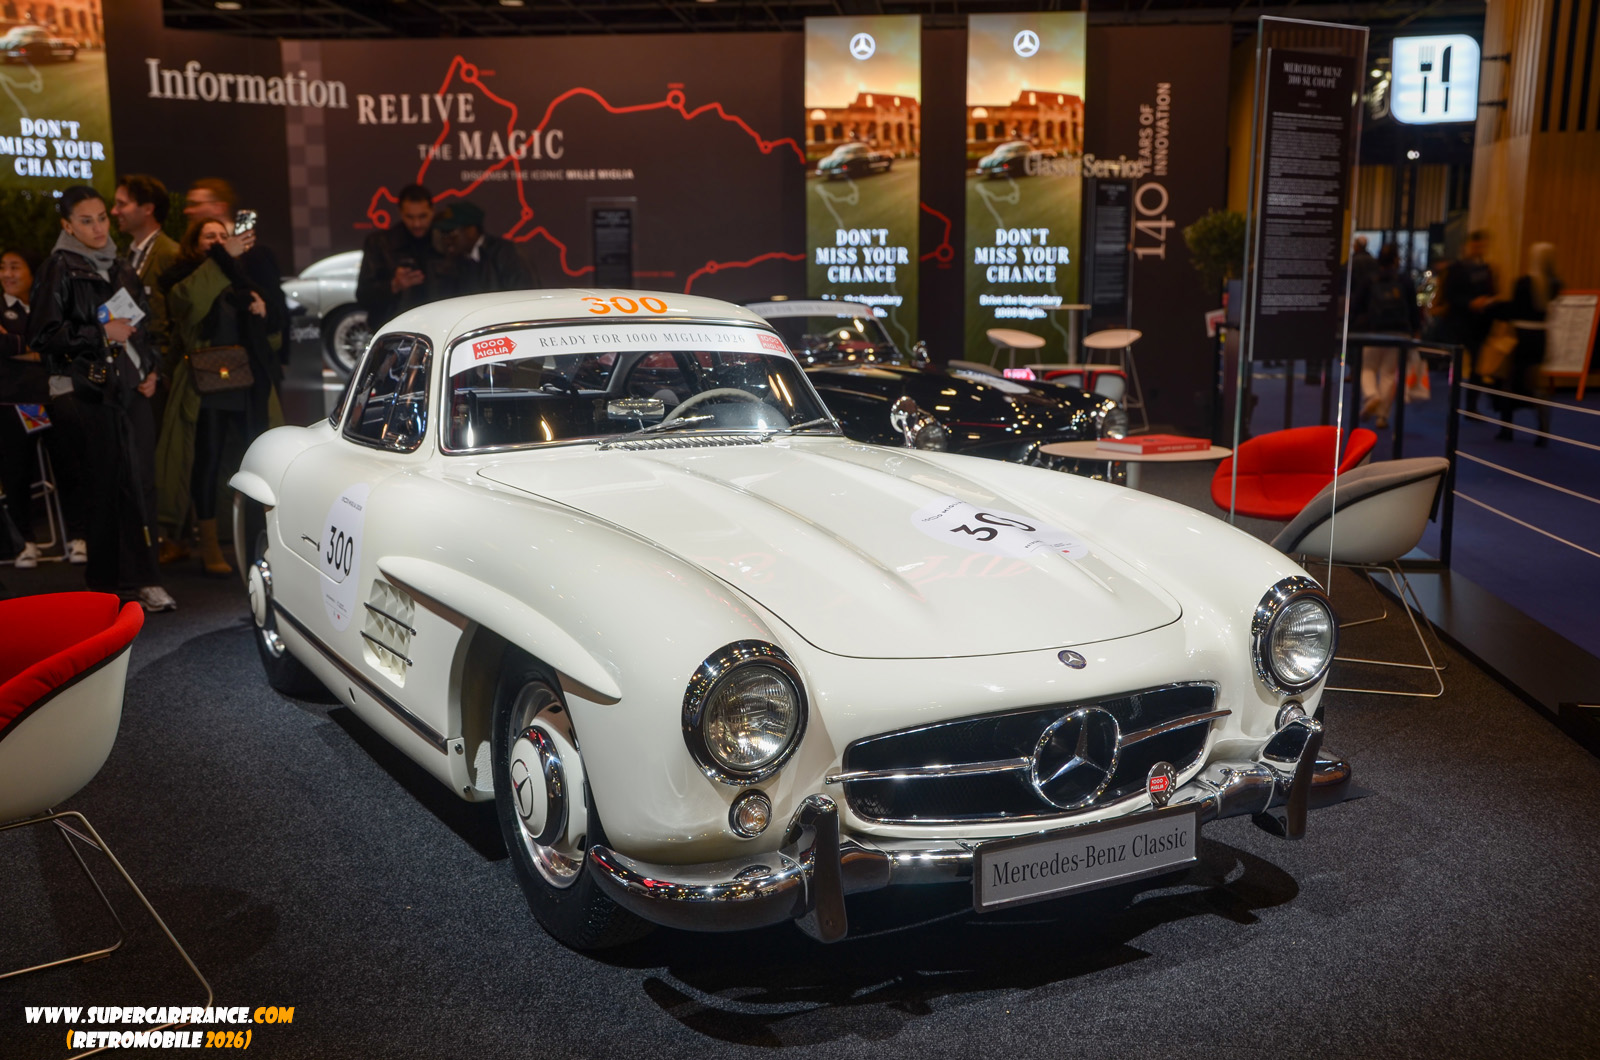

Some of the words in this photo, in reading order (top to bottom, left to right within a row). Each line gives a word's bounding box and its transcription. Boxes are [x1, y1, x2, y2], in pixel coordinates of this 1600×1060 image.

[145, 57, 349, 109] Information
[356, 93, 476, 124] RELIVE
[1140, 104, 1154, 126] OF
[20, 118, 80, 139] DON'T
[1154, 82, 1171, 176] INNOVATION
[0, 136, 47, 157] MISS
[52, 139, 105, 161] YOUR
[417, 144, 452, 160] THE
[458, 129, 565, 159] MAGIC
[1139, 128, 1153, 174] YEARS
[14, 157, 93, 179] CHANCE
[565, 169, 596, 180] MILLE
[597, 168, 634, 180] MIGLIA
[1024, 152, 1081, 177] Classic
[1083, 153, 1144, 178] Service
[1135, 182, 1175, 260] 140
[836, 228, 888, 246] DON'T
[995, 228, 1050, 246] DON'T
[816, 247, 858, 265] MISS
[862, 247, 909, 264] YOUR
[974, 247, 1017, 265] MISS
[1022, 246, 1070, 264] YOUR
[827, 265, 896, 283] CHANCE
[986, 265, 1056, 283] CHANCE
[580, 296, 668, 315] 300
[1018, 294, 1063, 307] legendary
[476, 339, 505, 350] 1000
[539, 335, 587, 348] READY
[593, 333, 622, 344] FOR
[626, 333, 658, 343] 1000
[663, 332, 712, 343] MIGLIA
[716, 334, 746, 344] 2026
[476, 347, 509, 359] MIGLIA
[327, 525, 354, 577] 300
[992, 844, 1126, 888] Mercedes-Benz
[1132, 827, 1188, 858] Classic
